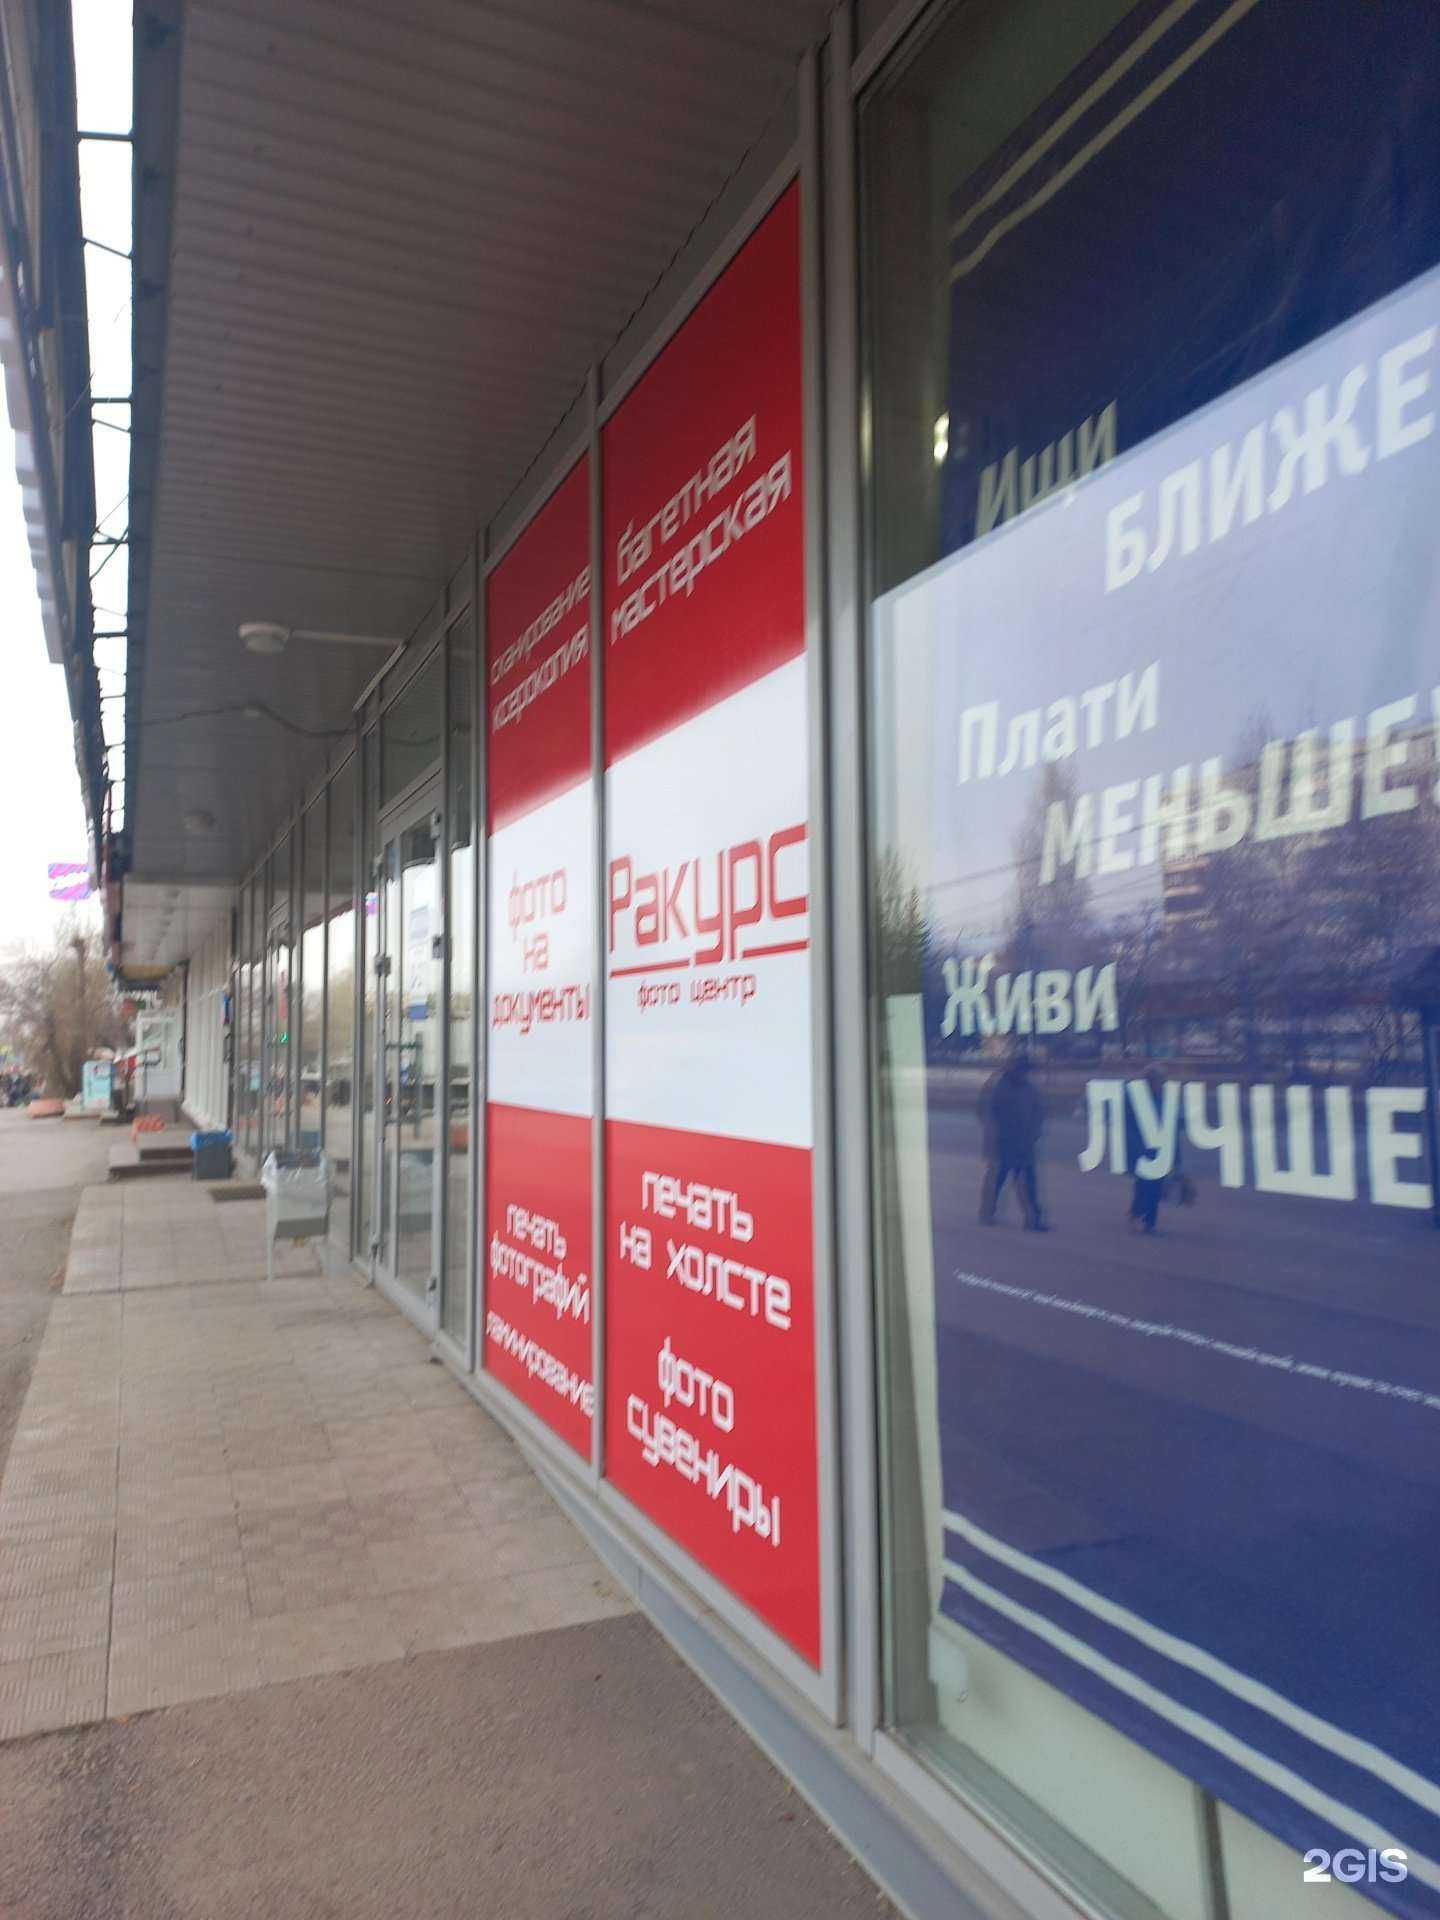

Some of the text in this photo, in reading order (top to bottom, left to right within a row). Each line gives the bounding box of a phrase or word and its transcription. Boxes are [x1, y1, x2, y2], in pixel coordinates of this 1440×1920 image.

[616, 413, 757, 587] багетная
[1105, 324, 1439, 595] БЛИЖЕ
[610, 449, 793, 646] мастерская
[492, 622, 590, 736] ксерокопия
[956, 659, 1160, 786] Плати
[508, 866, 568, 943] фото
[608, 821, 809, 967] Ракурс
[522, 930, 550, 974] на
[636, 973, 757, 1014] фото центр
[939, 953, 1120, 1039] Живи
[491, 983, 592, 1037] документы
[1078, 1078, 1434, 1210] ЛУЧШЕ
[506, 1203, 568, 1261] печать
[642, 1170, 755, 1243] печать
[490, 1230, 590, 1326] фотографий
[619, 1220, 792, 1330] на холсте
[657, 1336, 736, 1434] фото
[626, 1392, 781, 1549] сувениры
